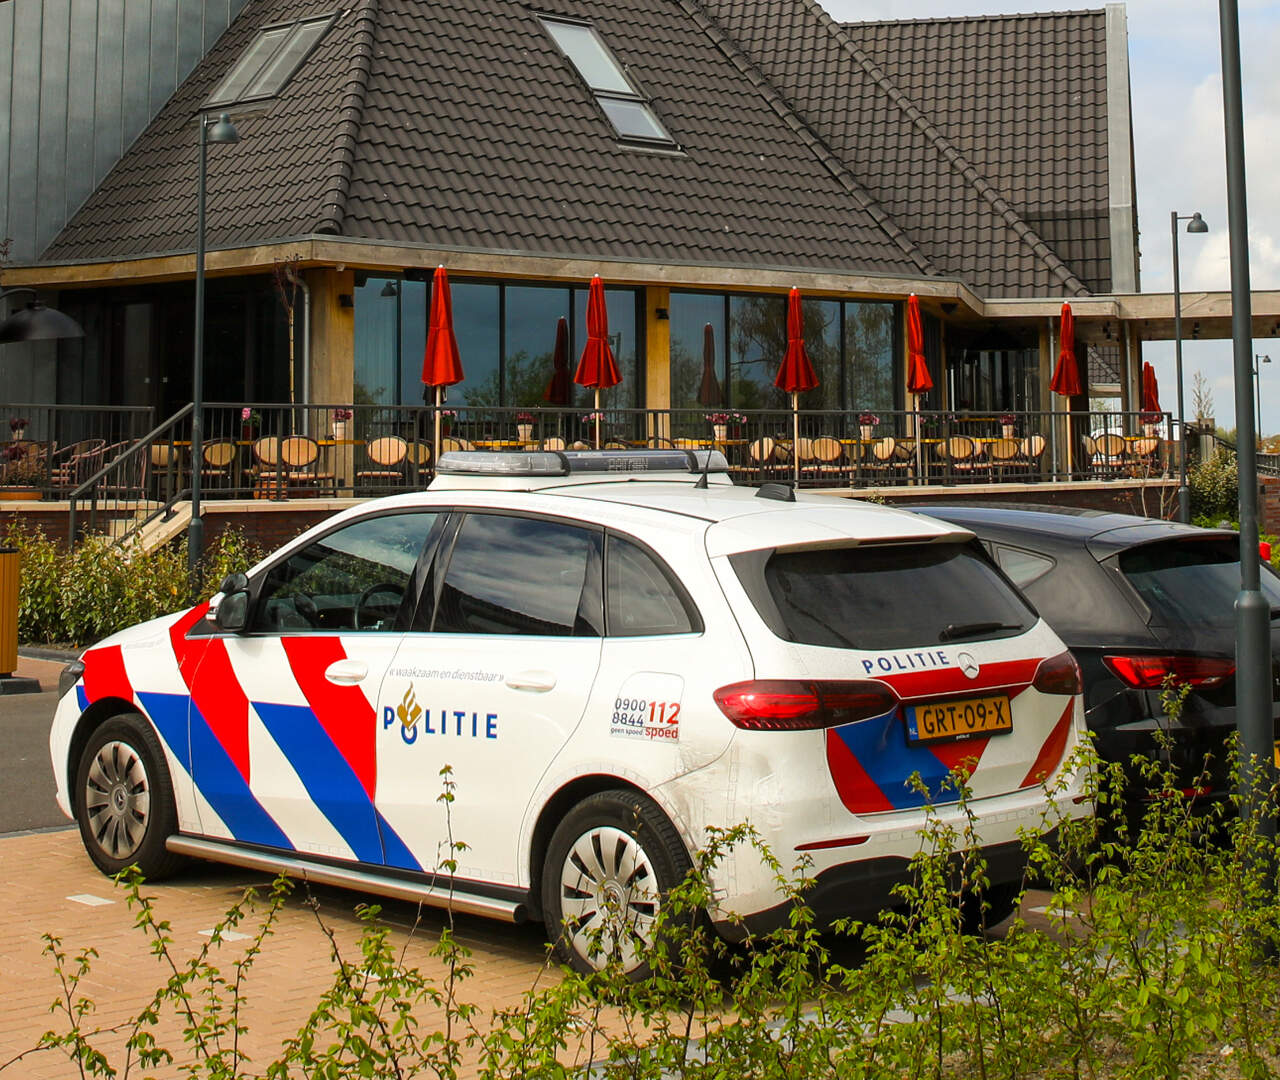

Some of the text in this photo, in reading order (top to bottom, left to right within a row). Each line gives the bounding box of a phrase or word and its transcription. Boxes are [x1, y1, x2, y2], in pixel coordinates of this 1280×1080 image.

[861, 651, 950, 674] POLITIE
[615, 698, 647, 712] 0900
[649, 700, 681, 724] 112
[383, 705, 498, 745] POLITIE
[611, 711, 644, 726] 8844
[923, 701, 1005, 734] GRT-09-X
[645, 726, 679, 740] spoed
